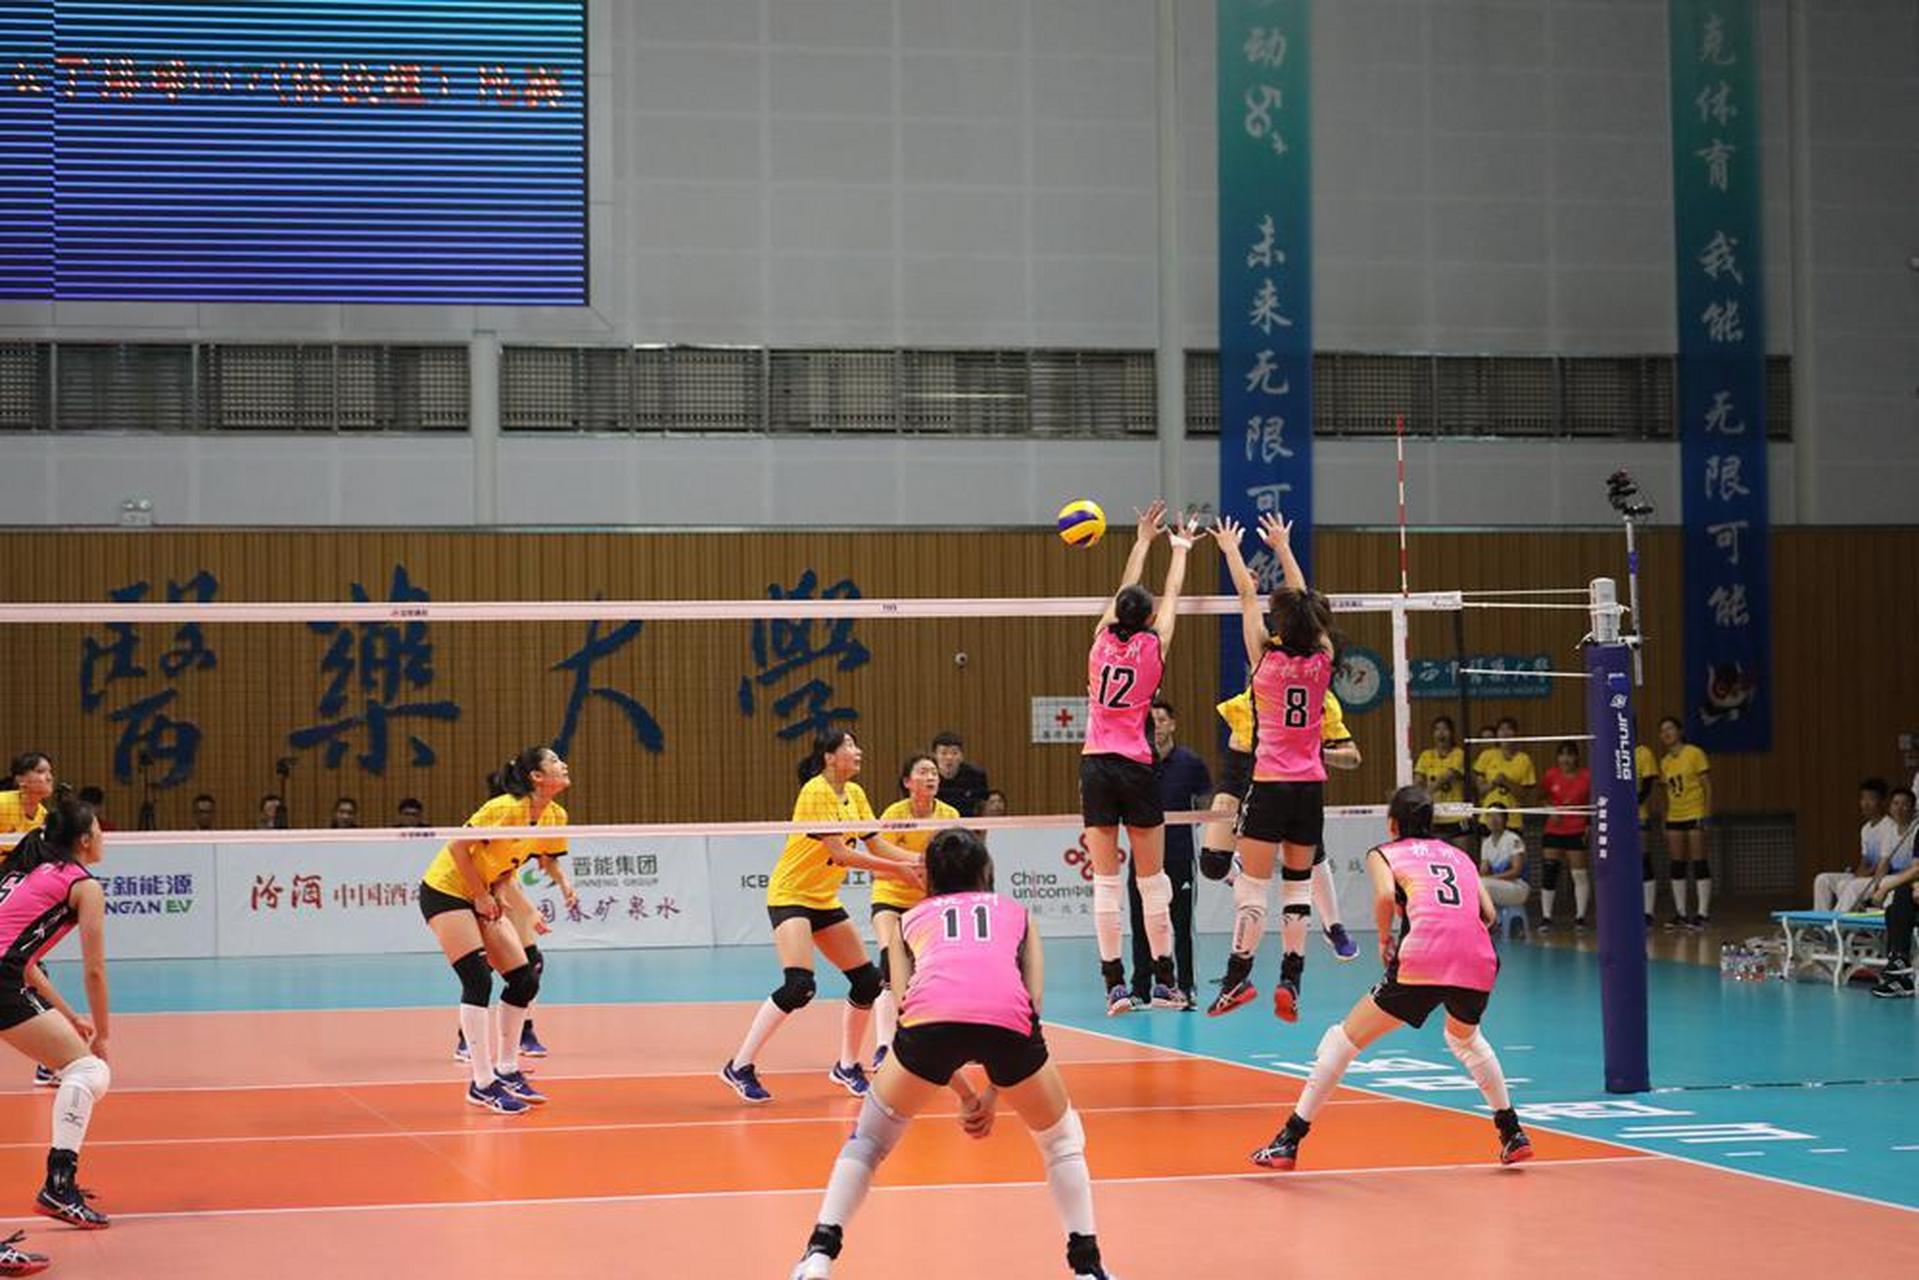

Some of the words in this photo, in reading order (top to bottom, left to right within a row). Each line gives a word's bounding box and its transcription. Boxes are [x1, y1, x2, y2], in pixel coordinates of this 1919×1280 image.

[1704, 391, 1751, 628] 无限可能
[1099, 663, 1136, 708] 12
[1284, 685, 1308, 728] 8
[572, 854, 657, 876] 晋能集团
[741, 874, 769, 889] ICB
[1011, 872, 1057, 885] China
[250, 874, 323, 911] 汾酒
[1013, 886, 1071, 899] unicom
[1428, 862, 1461, 906] 3
[104, 899, 161, 914] NGAN
[166, 899, 193, 913] EV
[941, 903, 990, 942] 11
